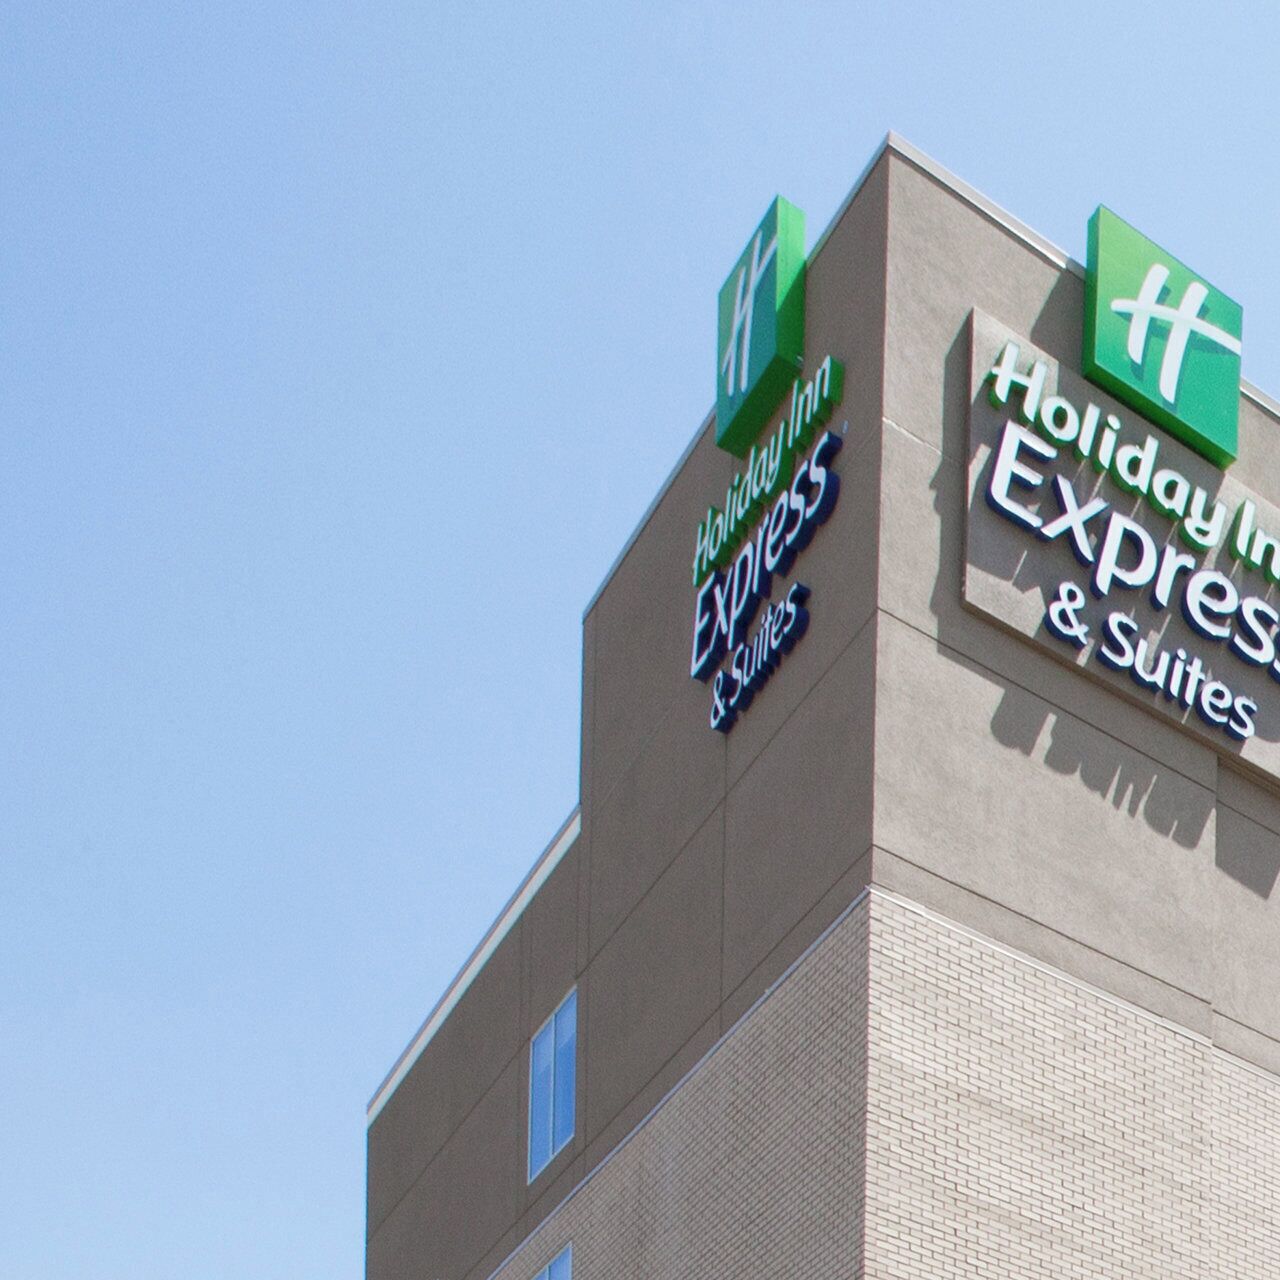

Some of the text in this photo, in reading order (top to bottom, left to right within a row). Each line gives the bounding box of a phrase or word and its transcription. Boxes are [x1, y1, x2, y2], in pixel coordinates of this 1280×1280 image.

[692, 355, 831, 586] Holiday Inn
[990, 340, 1227, 548] Holiday
[690, 431, 829, 677] Express
[710, 582, 800, 730] & Suites
[1048, 581, 1258, 739] & Suites
